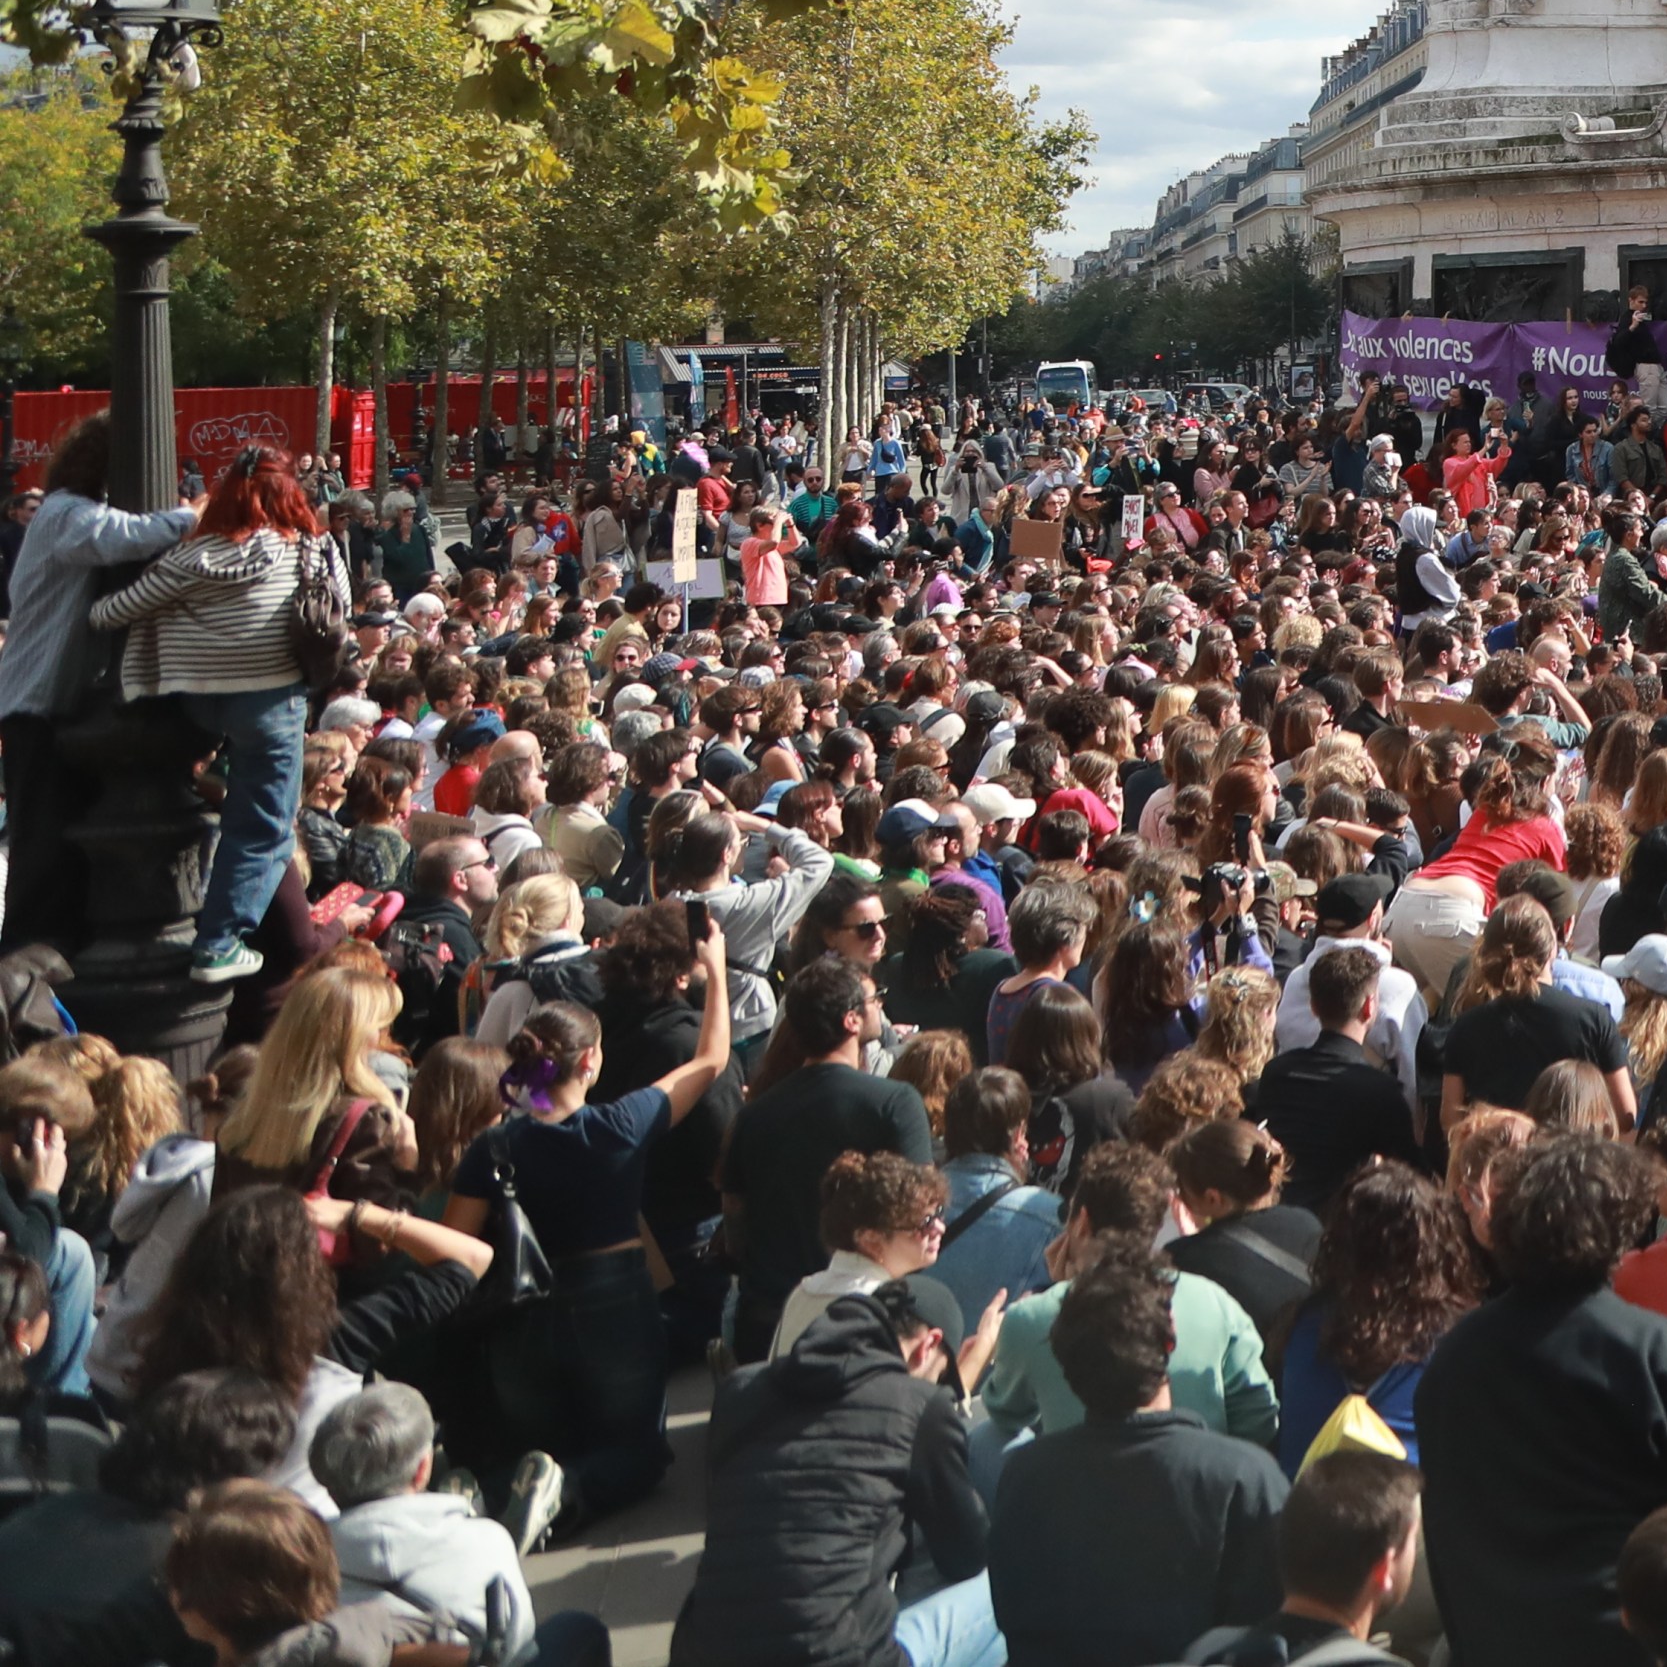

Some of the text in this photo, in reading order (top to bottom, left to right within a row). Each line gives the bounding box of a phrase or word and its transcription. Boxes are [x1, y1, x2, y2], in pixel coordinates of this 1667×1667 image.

[1526, 209, 1546, 225] AN
[1555, 207, 1565, 224] 2
[1358, 335, 1388, 359] aux
[1389, 329, 1474, 364] volences
[196, 417, 284, 446] MDMA
